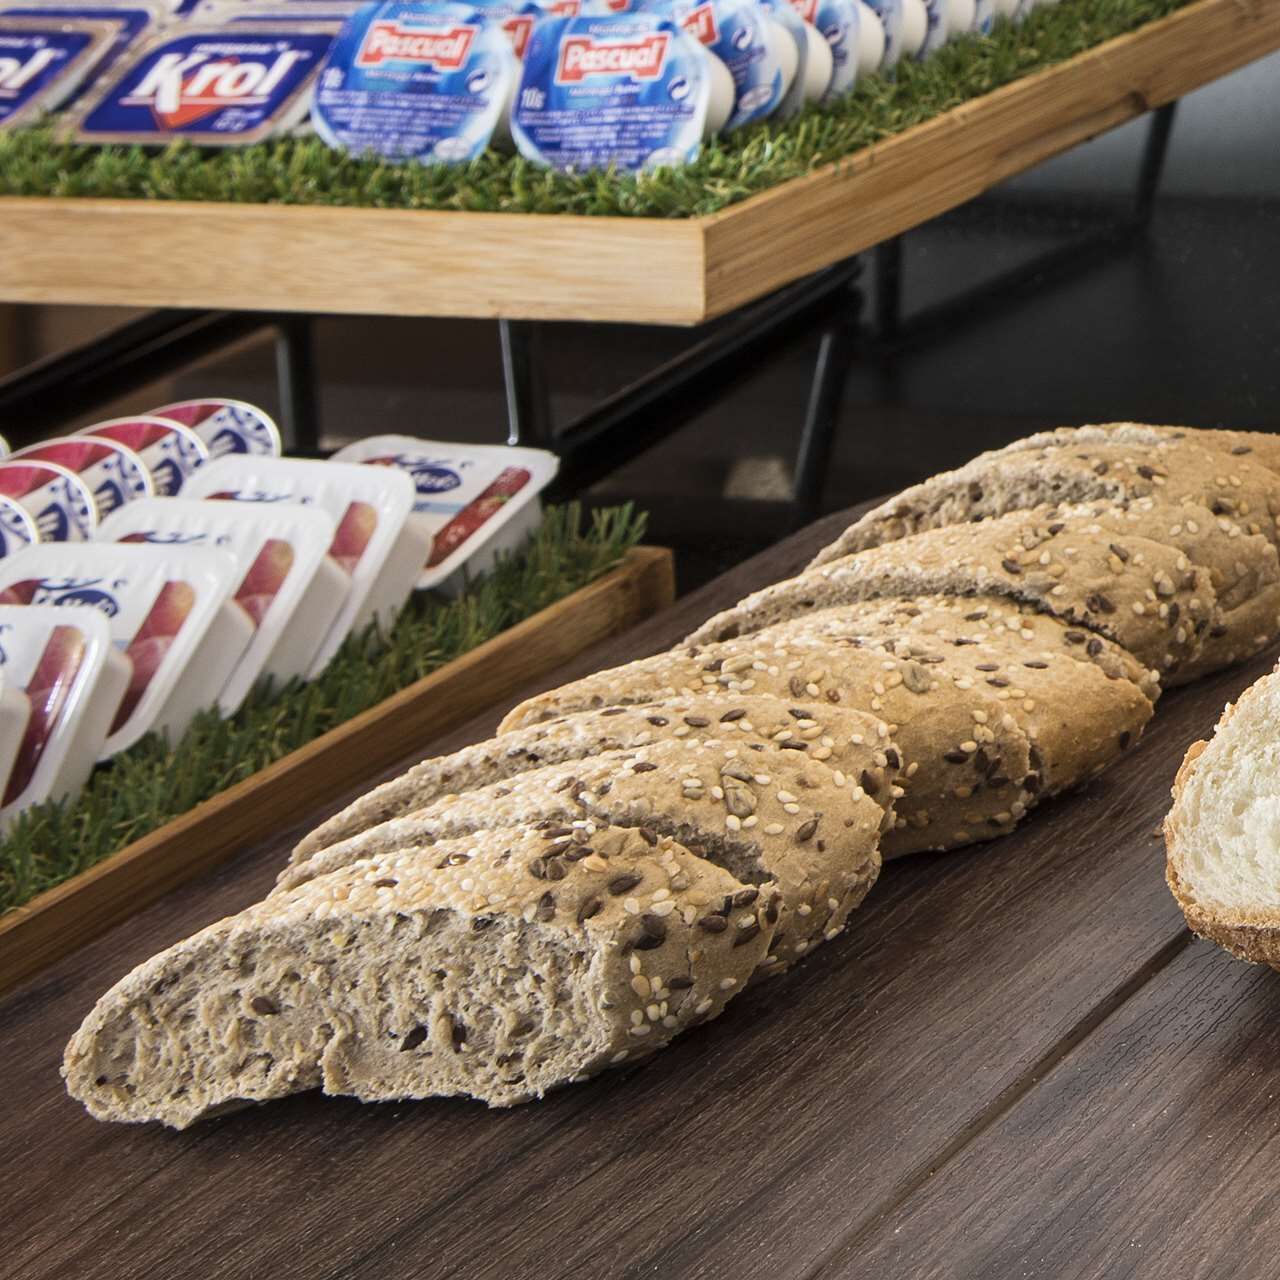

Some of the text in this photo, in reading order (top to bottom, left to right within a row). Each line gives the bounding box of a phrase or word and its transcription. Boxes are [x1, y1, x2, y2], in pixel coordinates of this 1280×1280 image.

[365, 26, 470, 60] Pascual
[564, 39, 661, 70] Pascual
[128, 50, 300, 113] Krol
